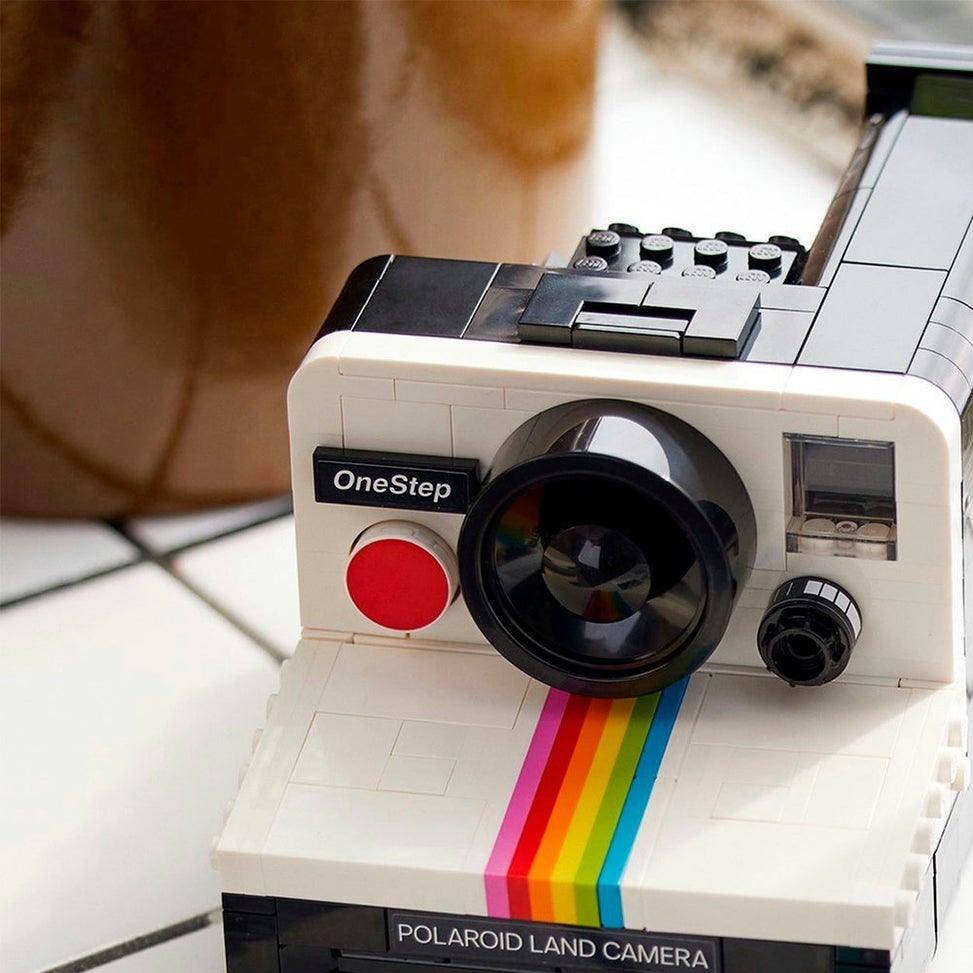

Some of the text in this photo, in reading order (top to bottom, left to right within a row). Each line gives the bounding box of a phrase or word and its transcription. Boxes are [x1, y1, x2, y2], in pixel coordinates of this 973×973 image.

[333, 469, 452, 503] OneStep
[398, 923, 709, 970] POLAROID LAND CAMERA
